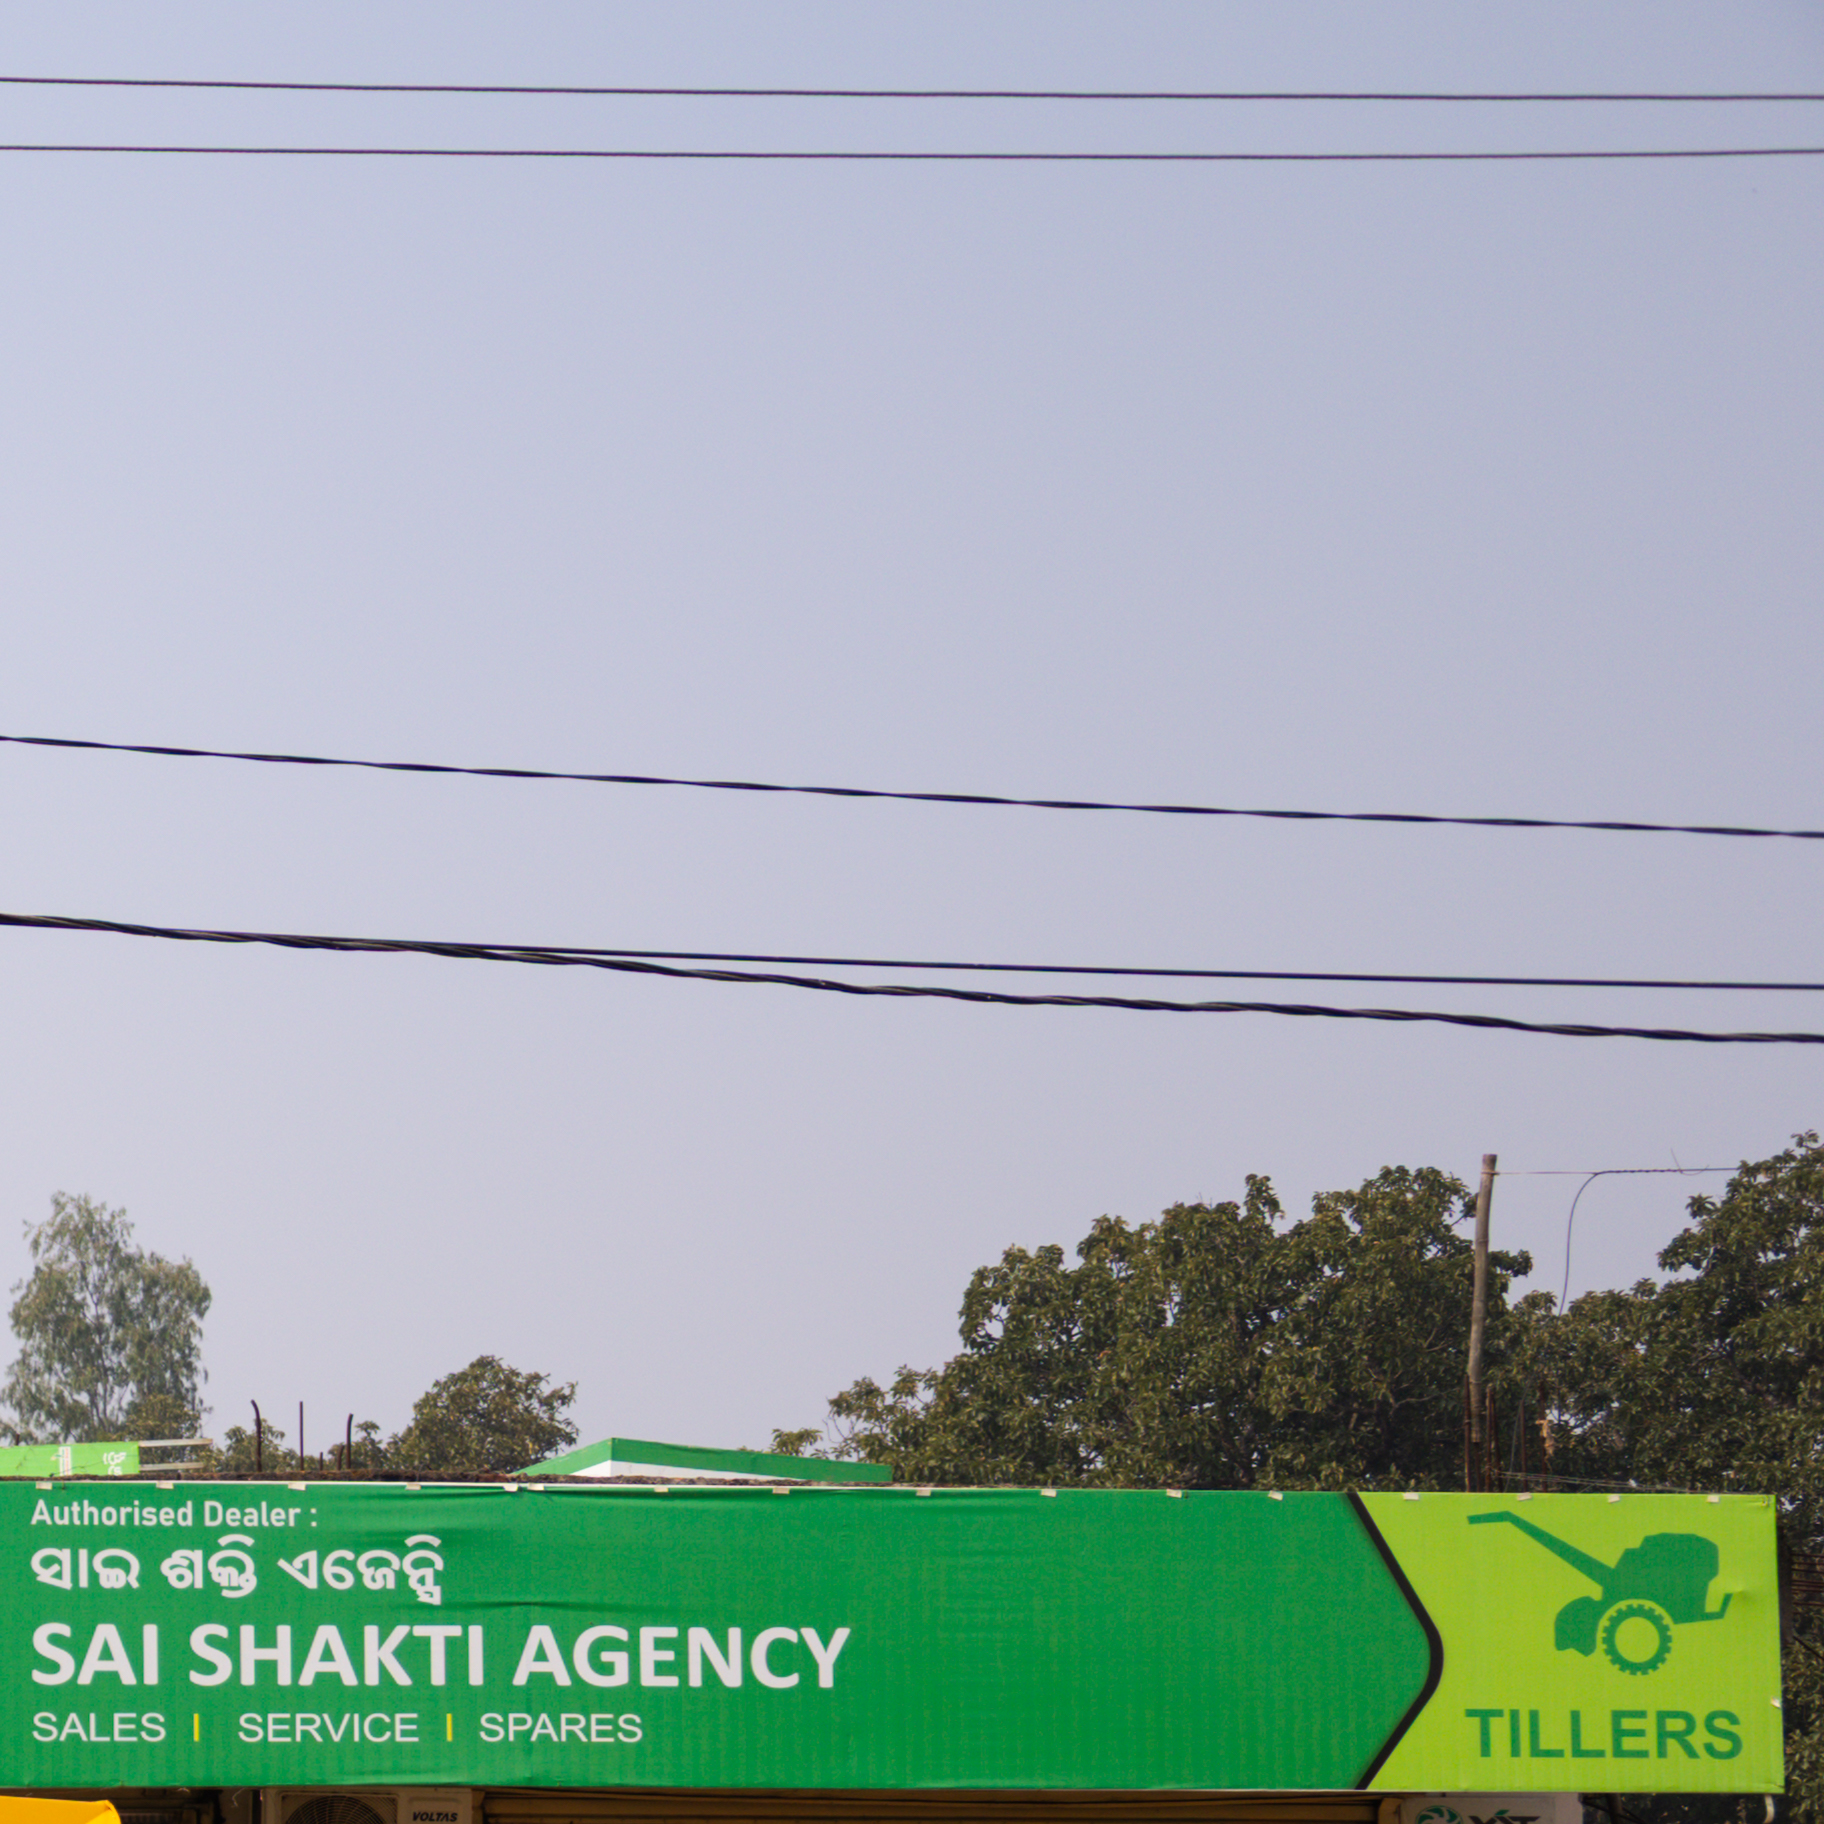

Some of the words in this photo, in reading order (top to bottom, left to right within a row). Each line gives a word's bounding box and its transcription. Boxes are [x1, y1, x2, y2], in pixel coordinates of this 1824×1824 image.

[31, 1499, 194, 1528] Authorised
[203, 1501, 301, 1528] Dealer
[31, 1545, 140, 1591] ସାଇ
[161, 1534, 257, 1598] ଶକ୍ତି
[277, 1534, 444, 1605] ଏଜେନ୍ସି
[31, 1622, 158, 1686] SAI
[189, 1623, 483, 1687] SHAKTI
[513, 1625, 851, 1690] AGENCY
[32, 1711, 166, 1744] SALES
[237, 1712, 419, 1744] SERVICE
[479, 1712, 643, 1744] SPARES
[1465, 1708, 1743, 1760] TILLERS
[412, 1811, 458, 1823] VOLTAS
